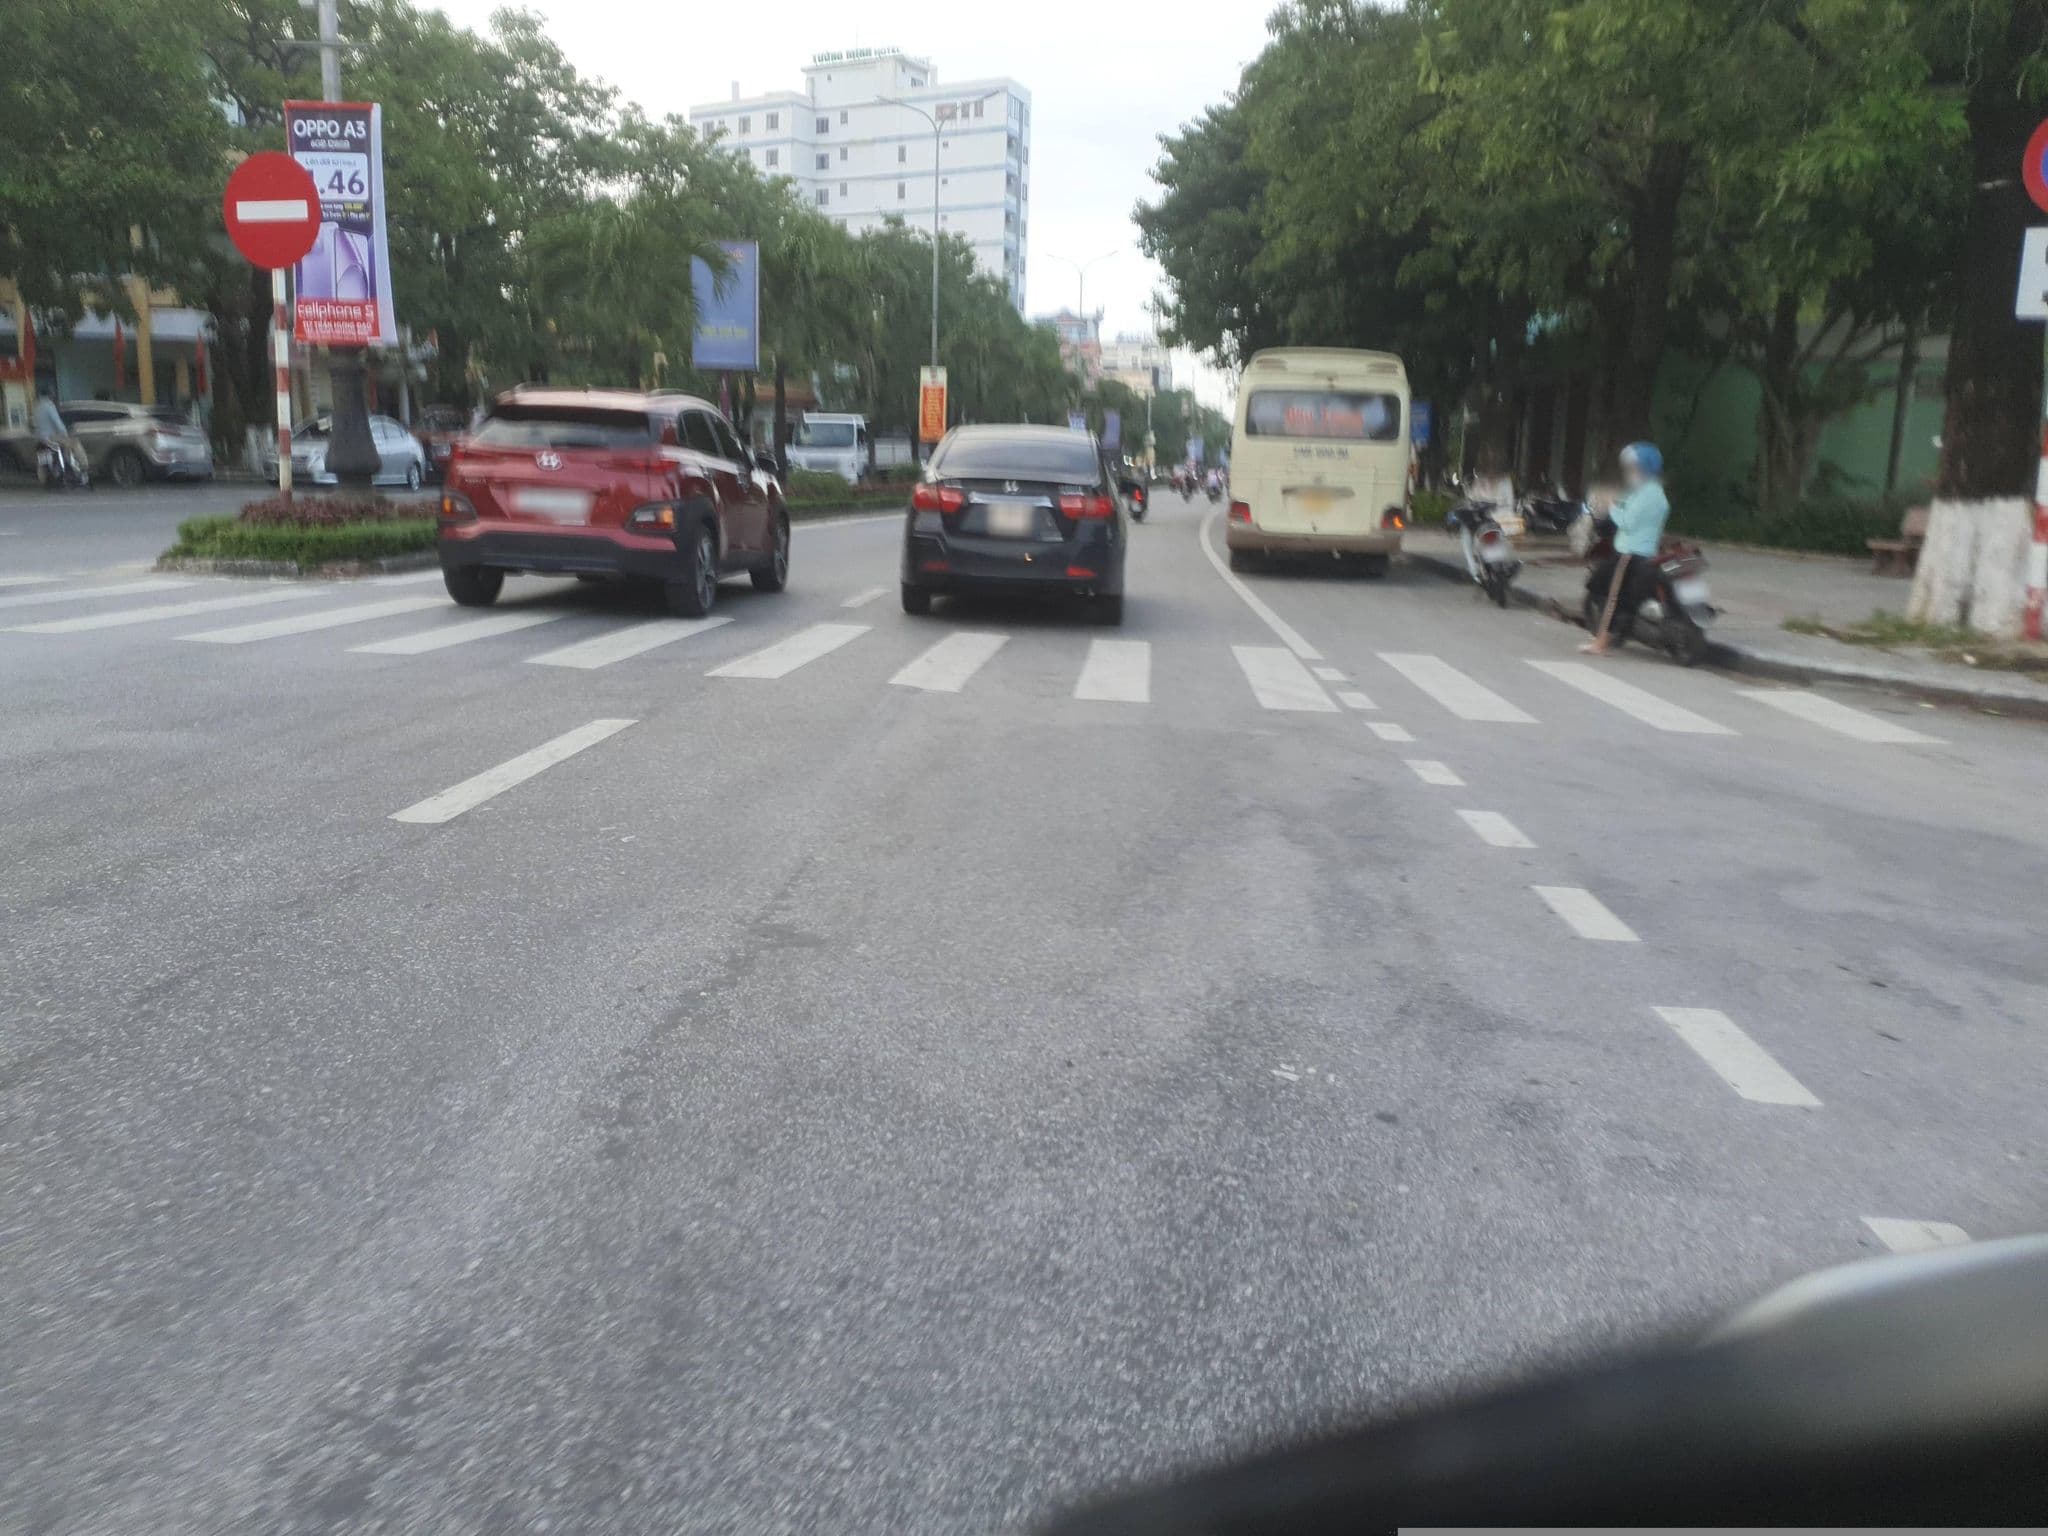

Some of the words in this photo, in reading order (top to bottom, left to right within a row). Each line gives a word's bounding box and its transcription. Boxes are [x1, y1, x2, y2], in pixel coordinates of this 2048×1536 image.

[293, 119, 340, 138] OPPO
[344, 120, 366, 138] A3
[309, 169, 365, 195] .46
